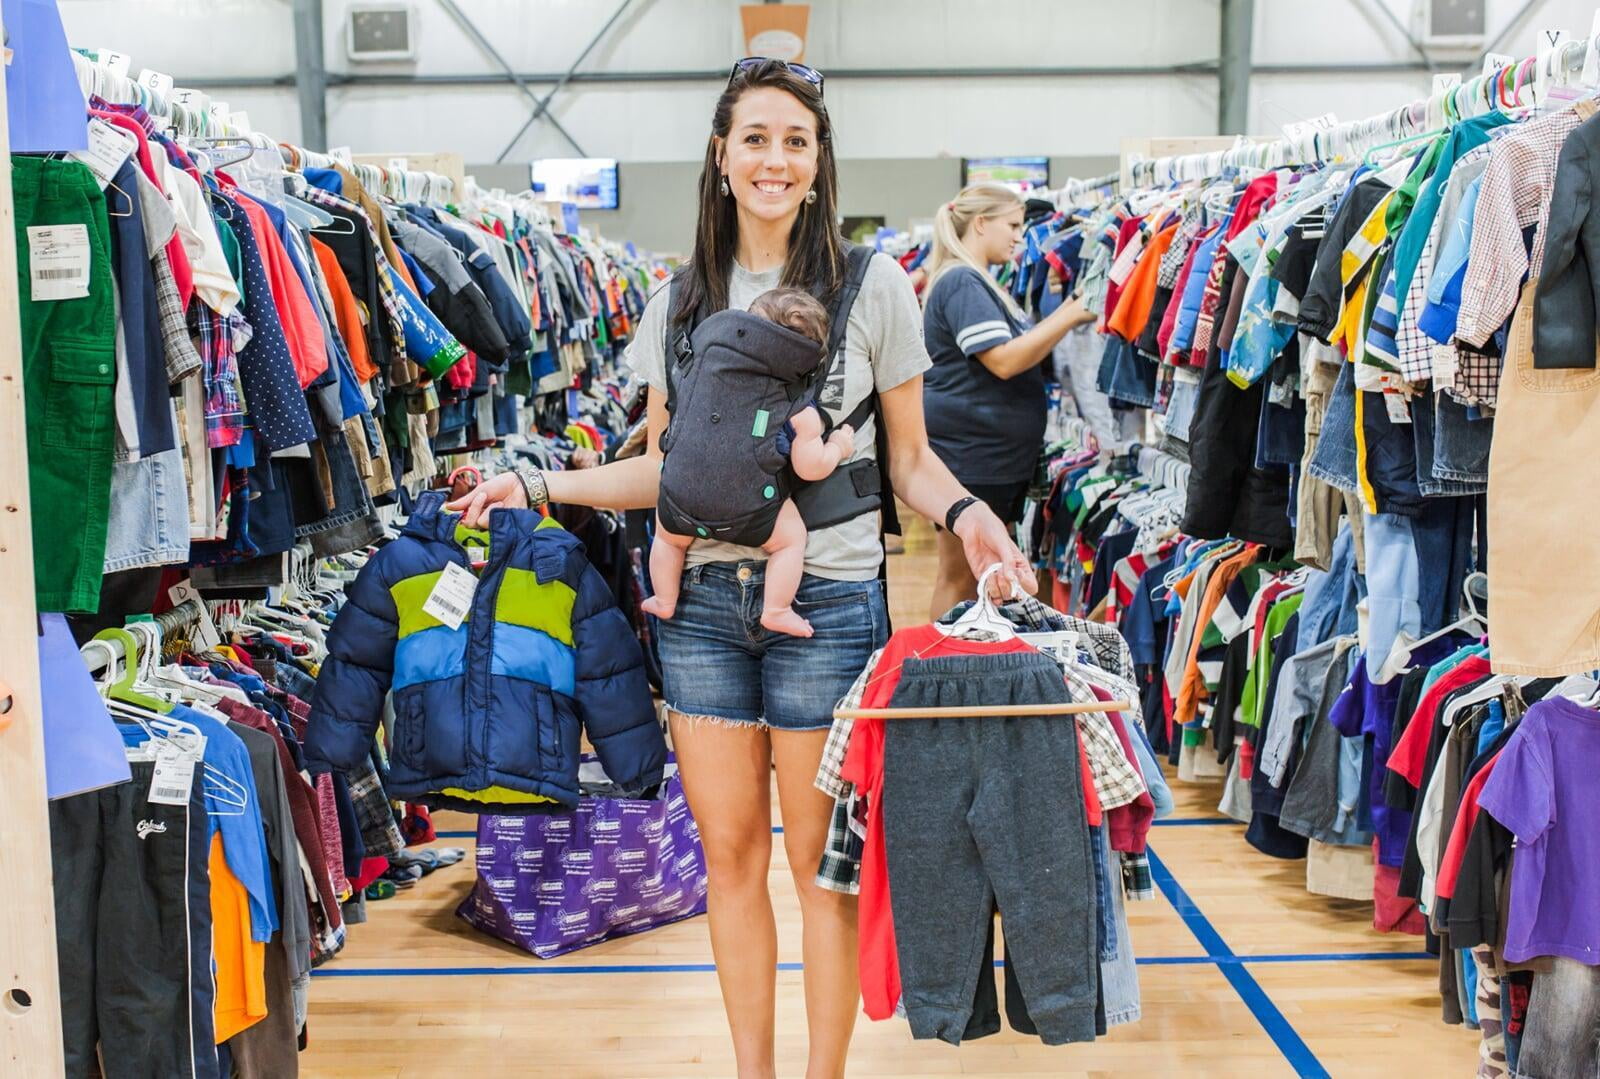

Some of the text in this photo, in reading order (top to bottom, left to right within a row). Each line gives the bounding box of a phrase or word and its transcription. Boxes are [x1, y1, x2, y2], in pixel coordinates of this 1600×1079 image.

[1546, 31, 1560, 47] Y
[107, 54, 120, 68] F
[149, 73, 159, 88] G
[180, 92, 192, 104] I
[175, 586, 188, 600] D
